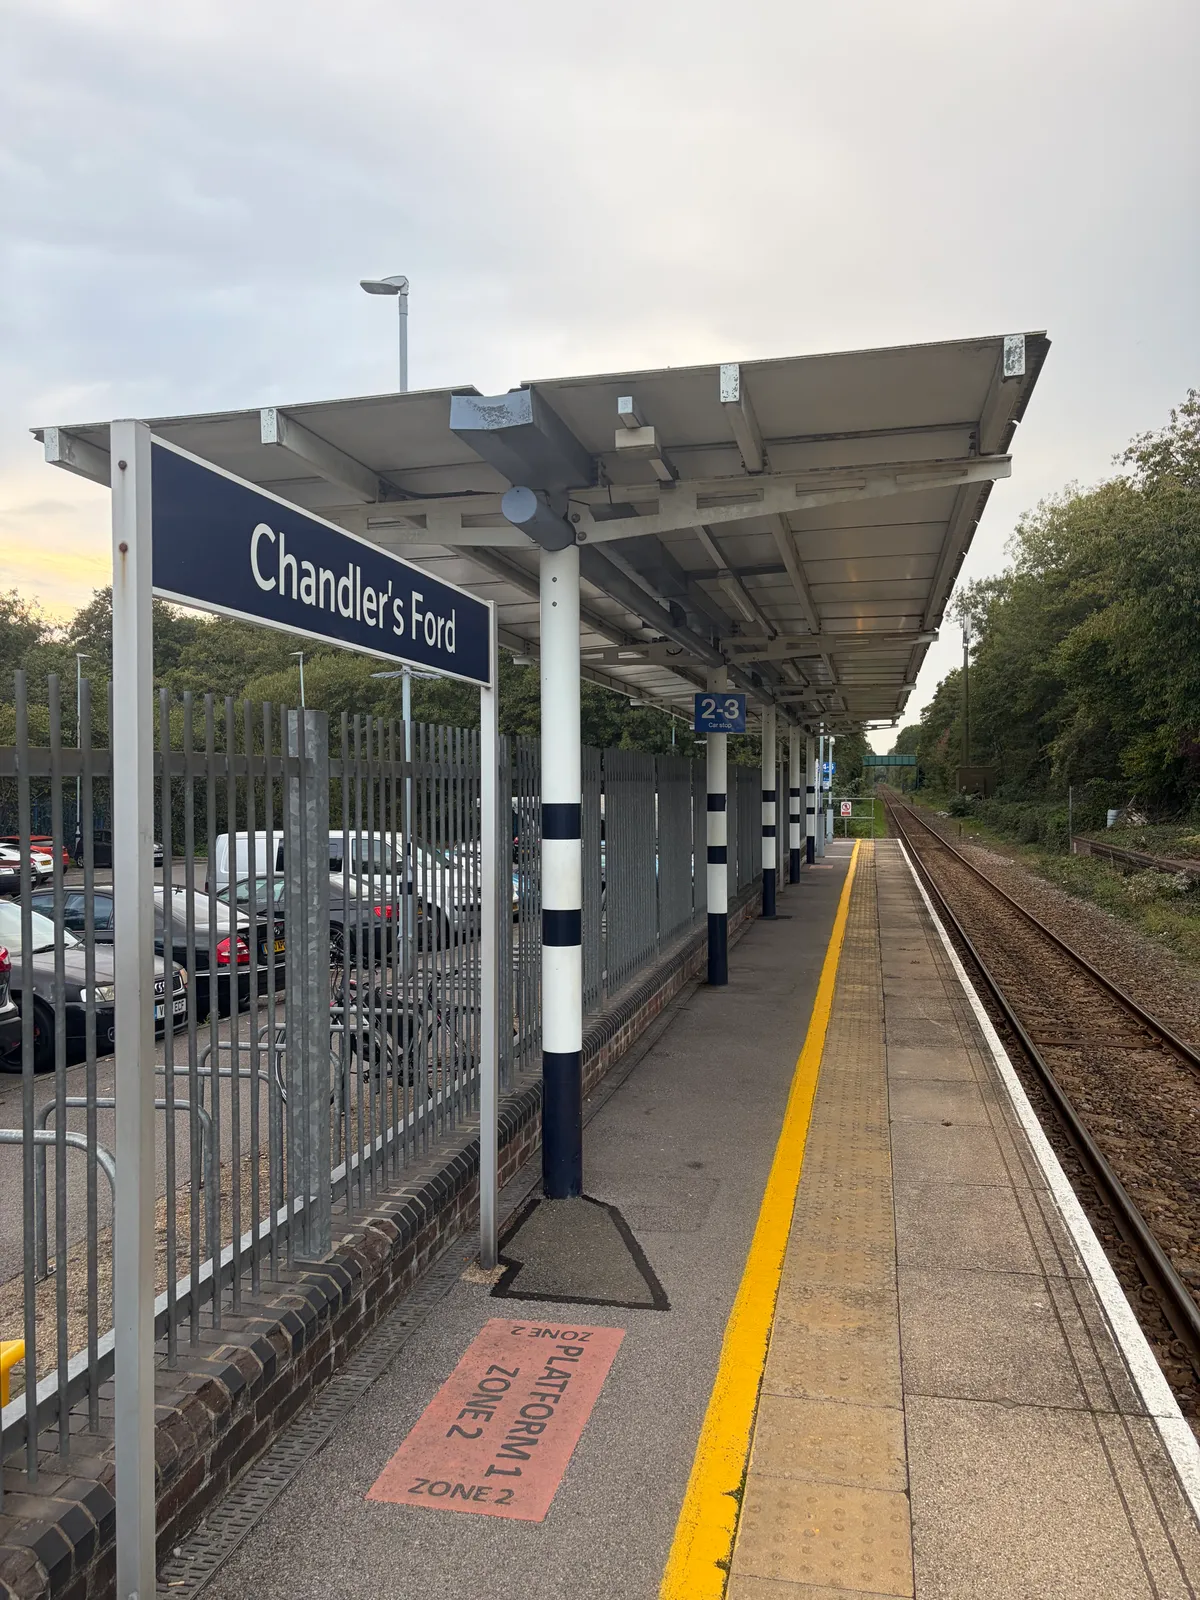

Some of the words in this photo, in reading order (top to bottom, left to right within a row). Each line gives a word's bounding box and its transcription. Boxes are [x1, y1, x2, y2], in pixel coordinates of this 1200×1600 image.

[250, 523, 404, 636] Chandler's
[411, 590, 456, 654] Ford
[701, 698, 740, 719] 2-3
[510, 1325, 526, 1336] 2
[527, 1327, 594, 1342] ZONE
[456, 1364, 520, 1423] ZONE
[495, 1344, 584, 1461] PLATFORM
[446, 1424, 483, 1440] 2
[484, 1464, 523, 1478] 1
[407, 1477, 493, 1503] ZONE
[494, 1488, 515, 1506] 2
